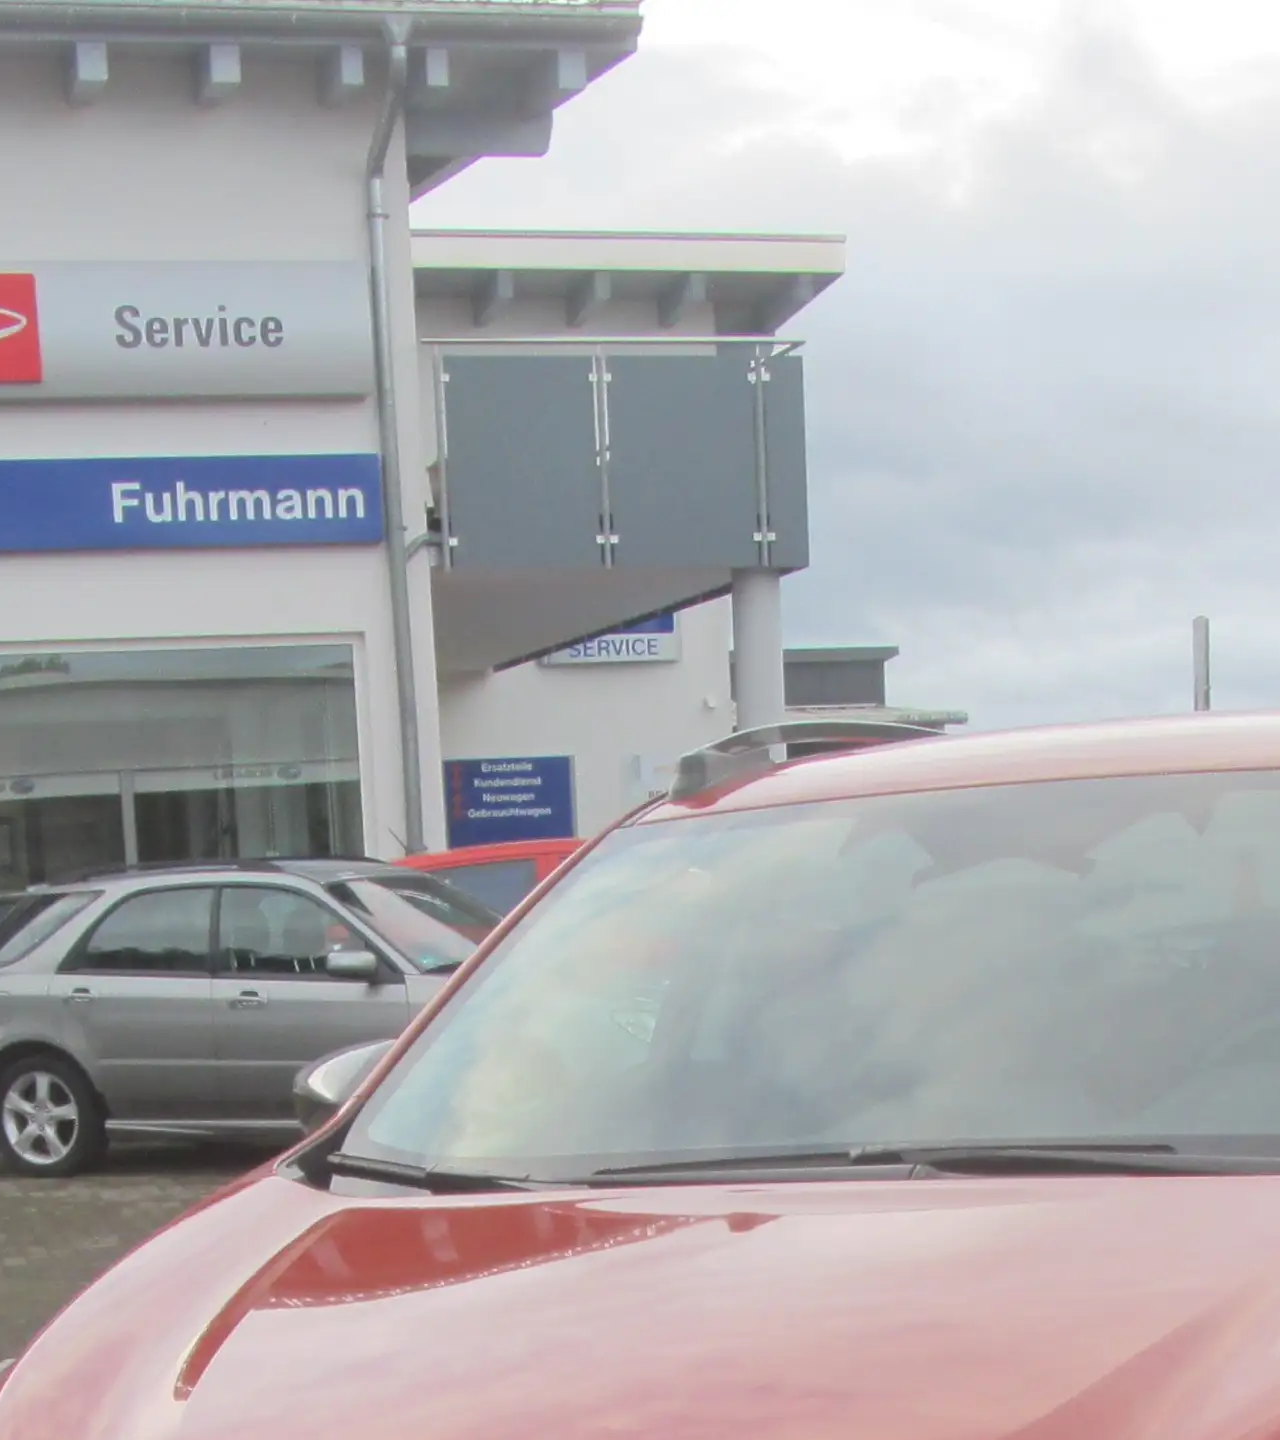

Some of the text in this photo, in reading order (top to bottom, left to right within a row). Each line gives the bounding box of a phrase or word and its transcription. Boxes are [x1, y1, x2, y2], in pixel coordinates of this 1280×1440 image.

[113, 303, 285, 350] Service
[111, 480, 366, 524] Fuhrmann
[568, 638, 660, 658] SERVICE
